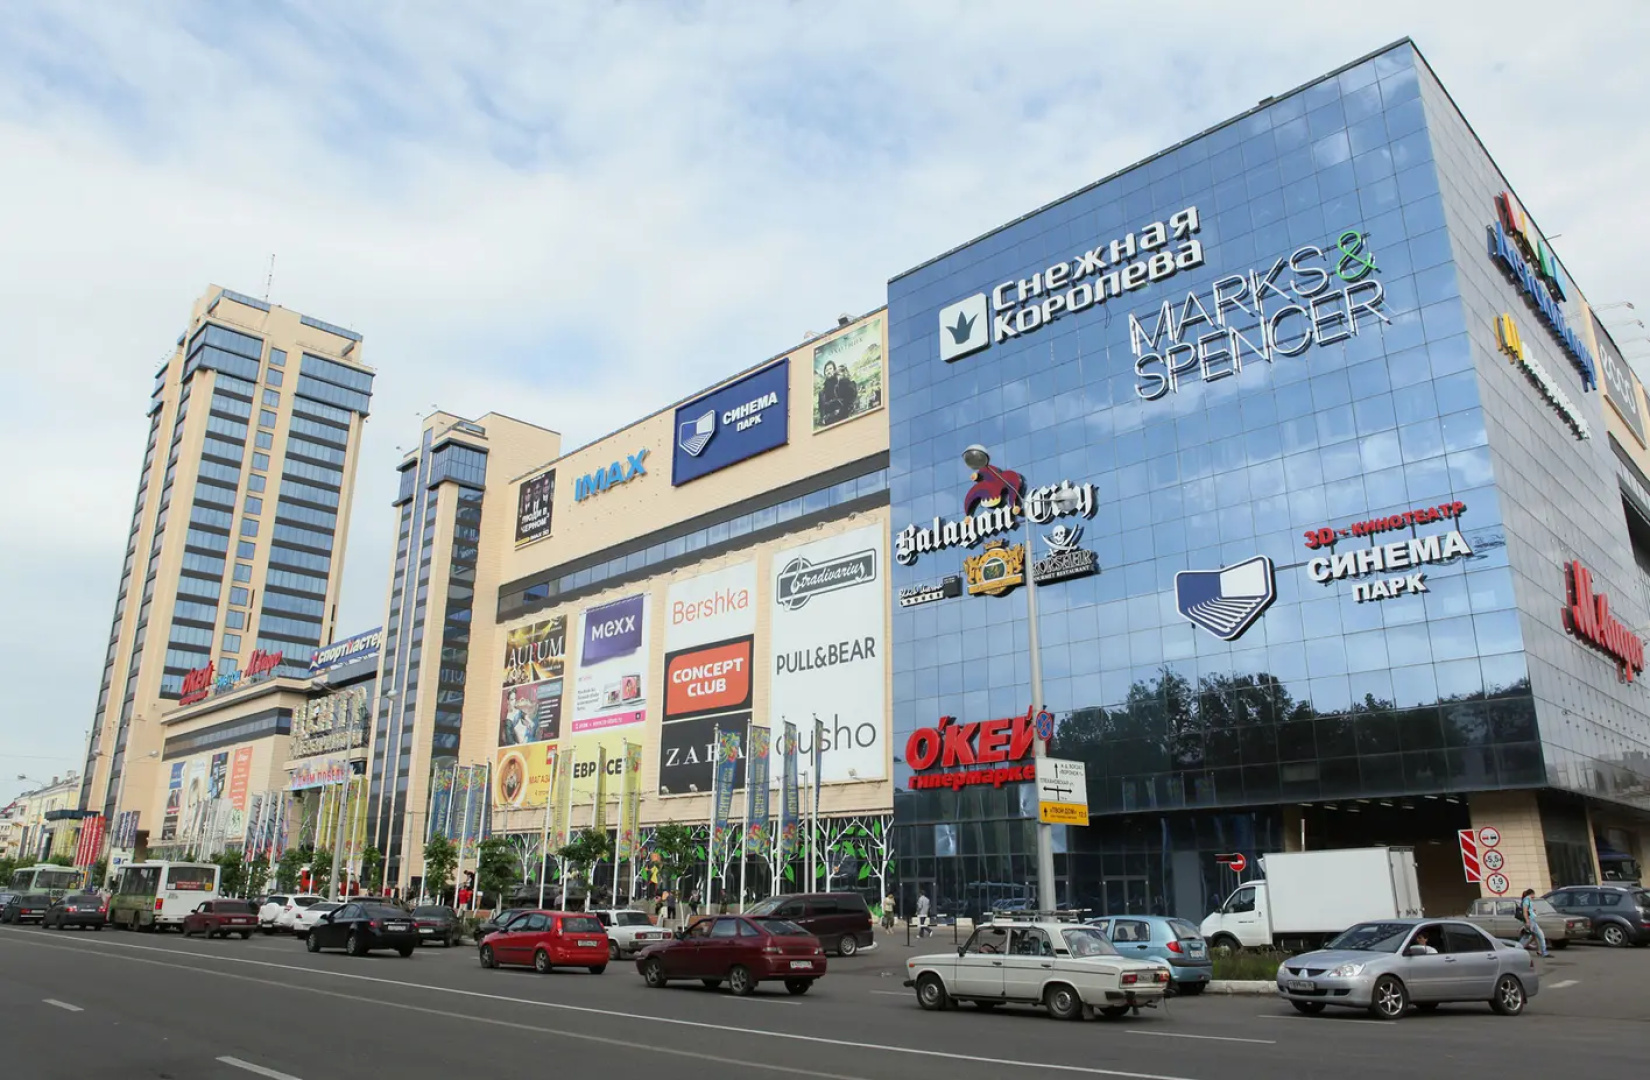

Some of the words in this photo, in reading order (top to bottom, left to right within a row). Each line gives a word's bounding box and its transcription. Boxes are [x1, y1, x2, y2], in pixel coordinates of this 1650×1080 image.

[1133, 279, 1392, 400] SPENCER
[723, 391, 778, 425] СИНЕМА
[736, 411, 762, 432] ПАРК
[574, 448, 648, 502] IMAX
[895, 505, 1015, 566] Balagan
[1307, 530, 1473, 582] СИНЕМА
[786, 555, 867, 597] Stradivarius
[1352, 572, 1428, 602] ПАРК
[672, 588, 749, 626] Bershka
[507, 635, 566, 671] AURUM
[672, 657, 744, 684] CONCEPT
[776, 636, 876, 675] PULL&BEAR
[687, 678, 727, 698] CLUB
[665, 741, 747, 768] ZAR
[529, 774, 551, 785] МАГАЗ
[908, 764, 1036, 792] гипермарке
